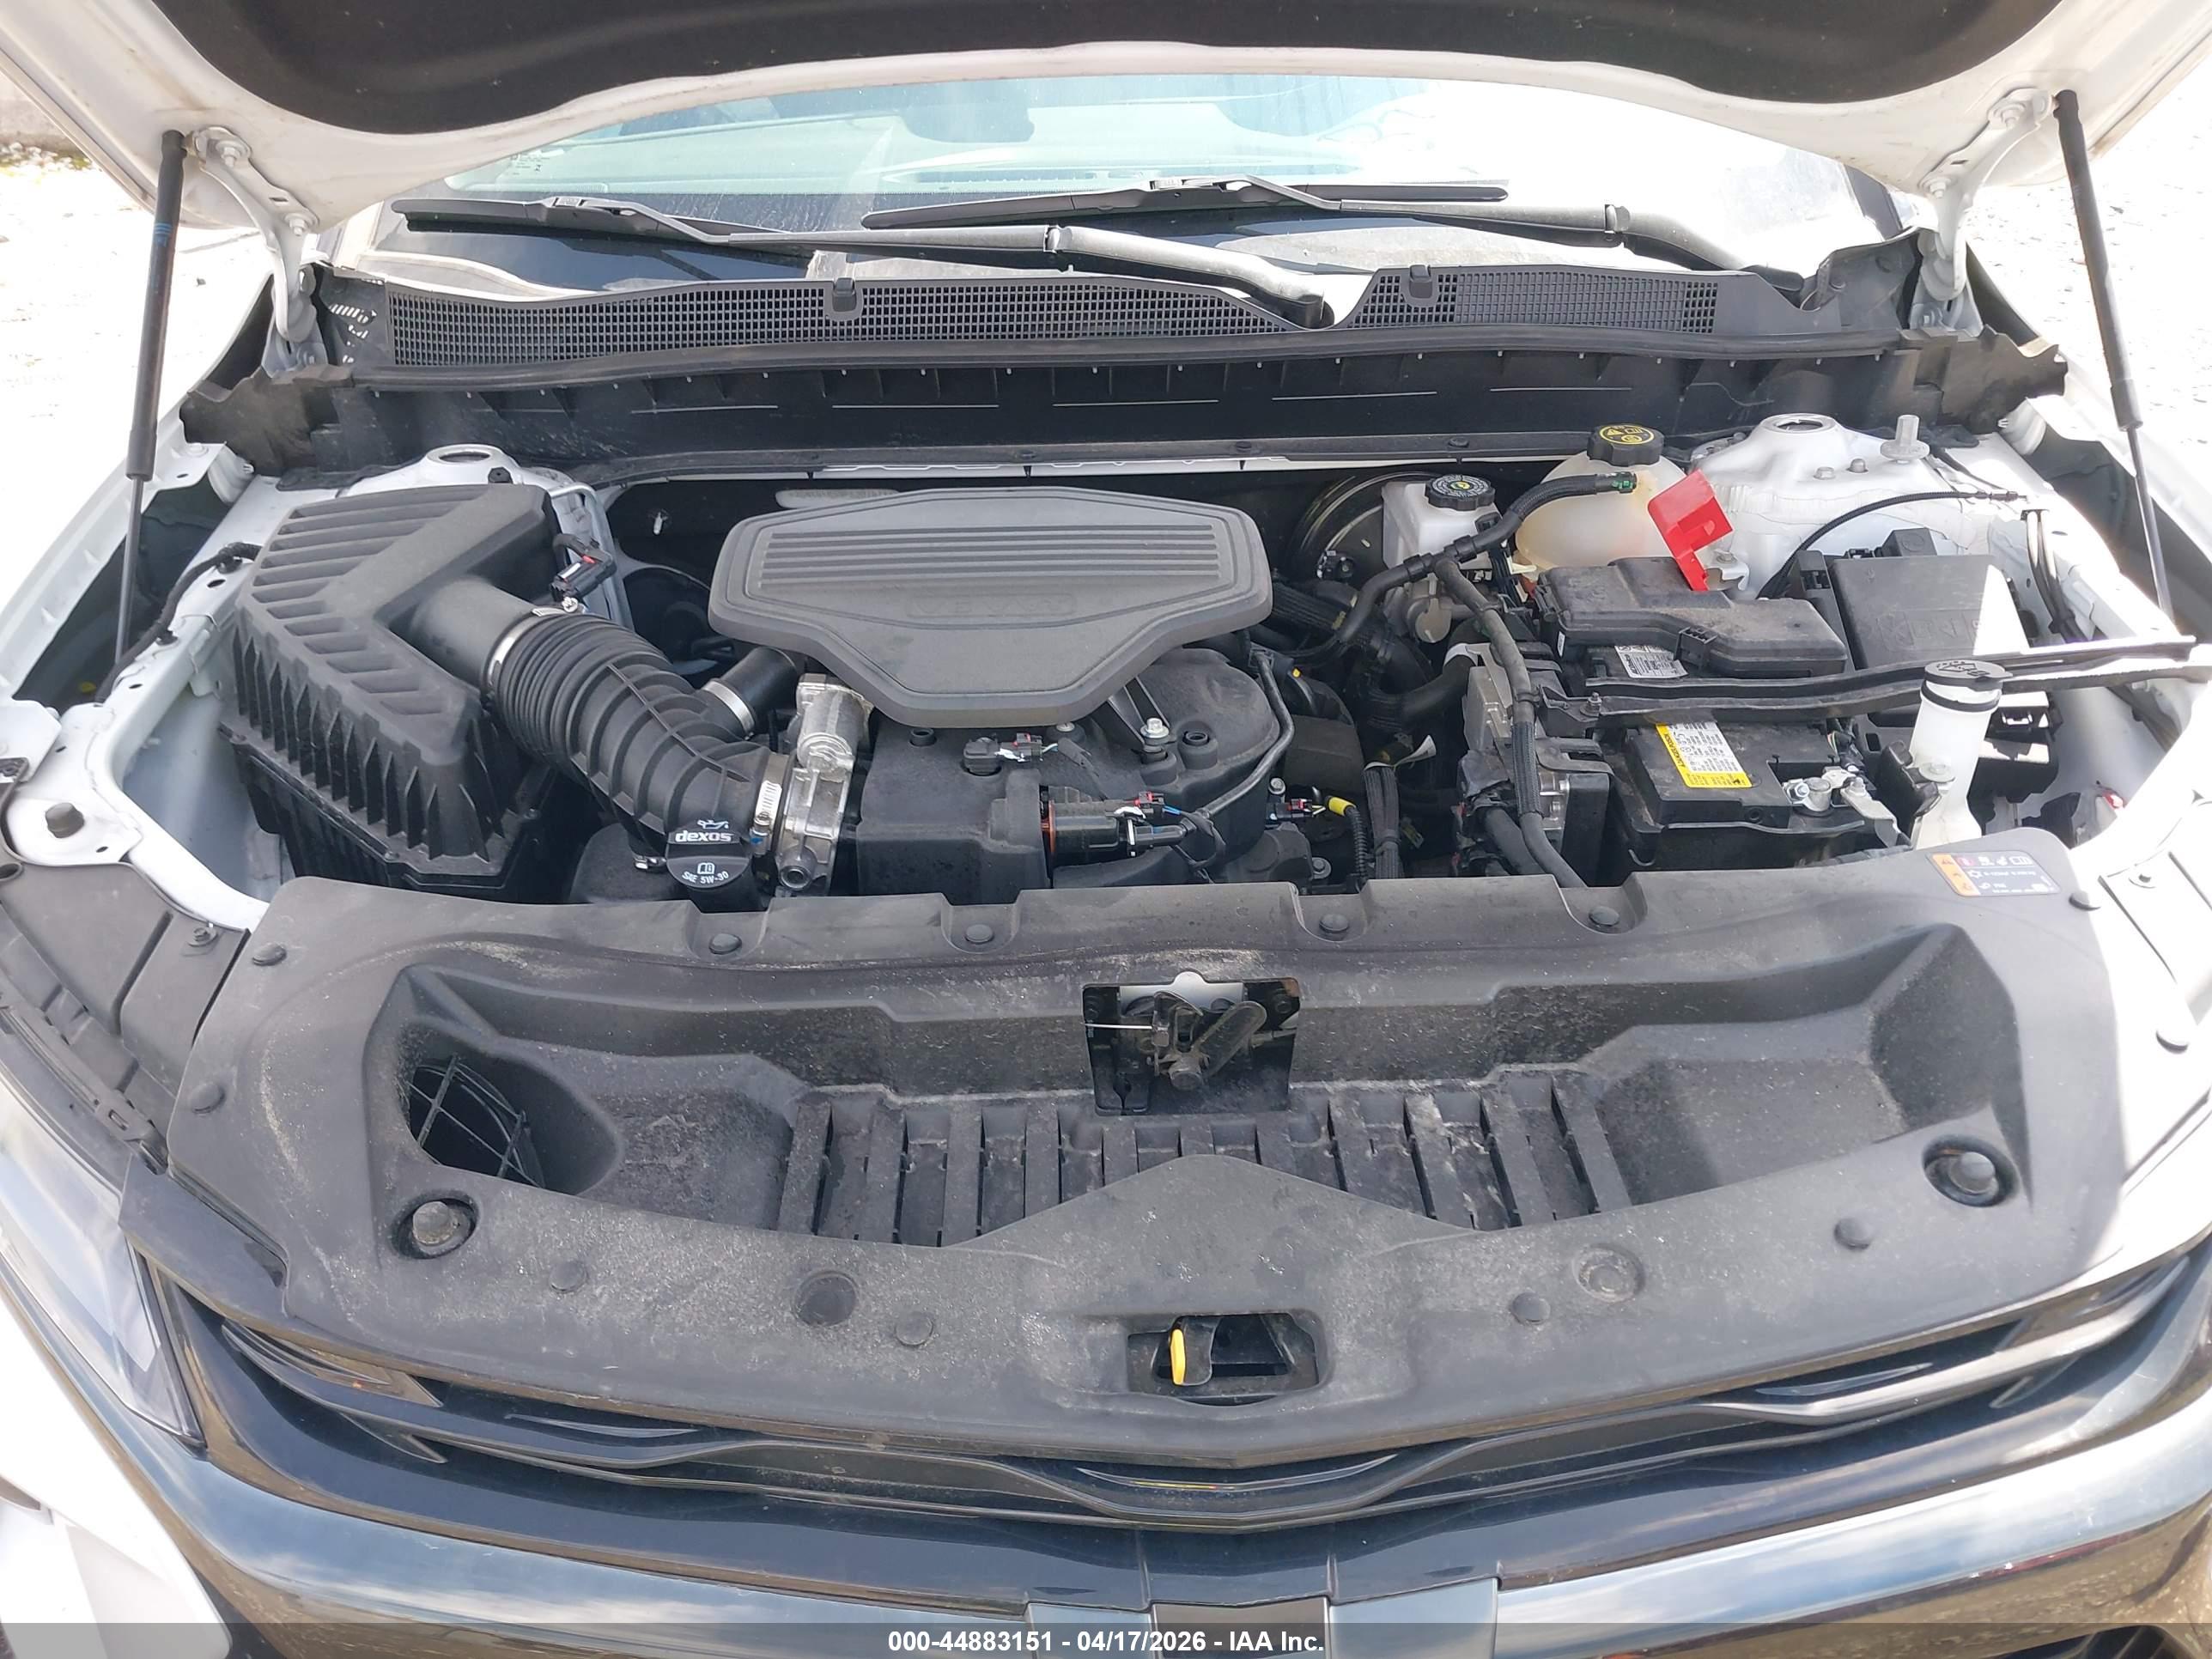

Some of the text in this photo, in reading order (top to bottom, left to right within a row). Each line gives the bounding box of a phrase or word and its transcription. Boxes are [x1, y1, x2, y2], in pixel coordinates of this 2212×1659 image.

[675, 830, 734, 842] dexos
[682, 871, 729, 884] SAE 5W-30
